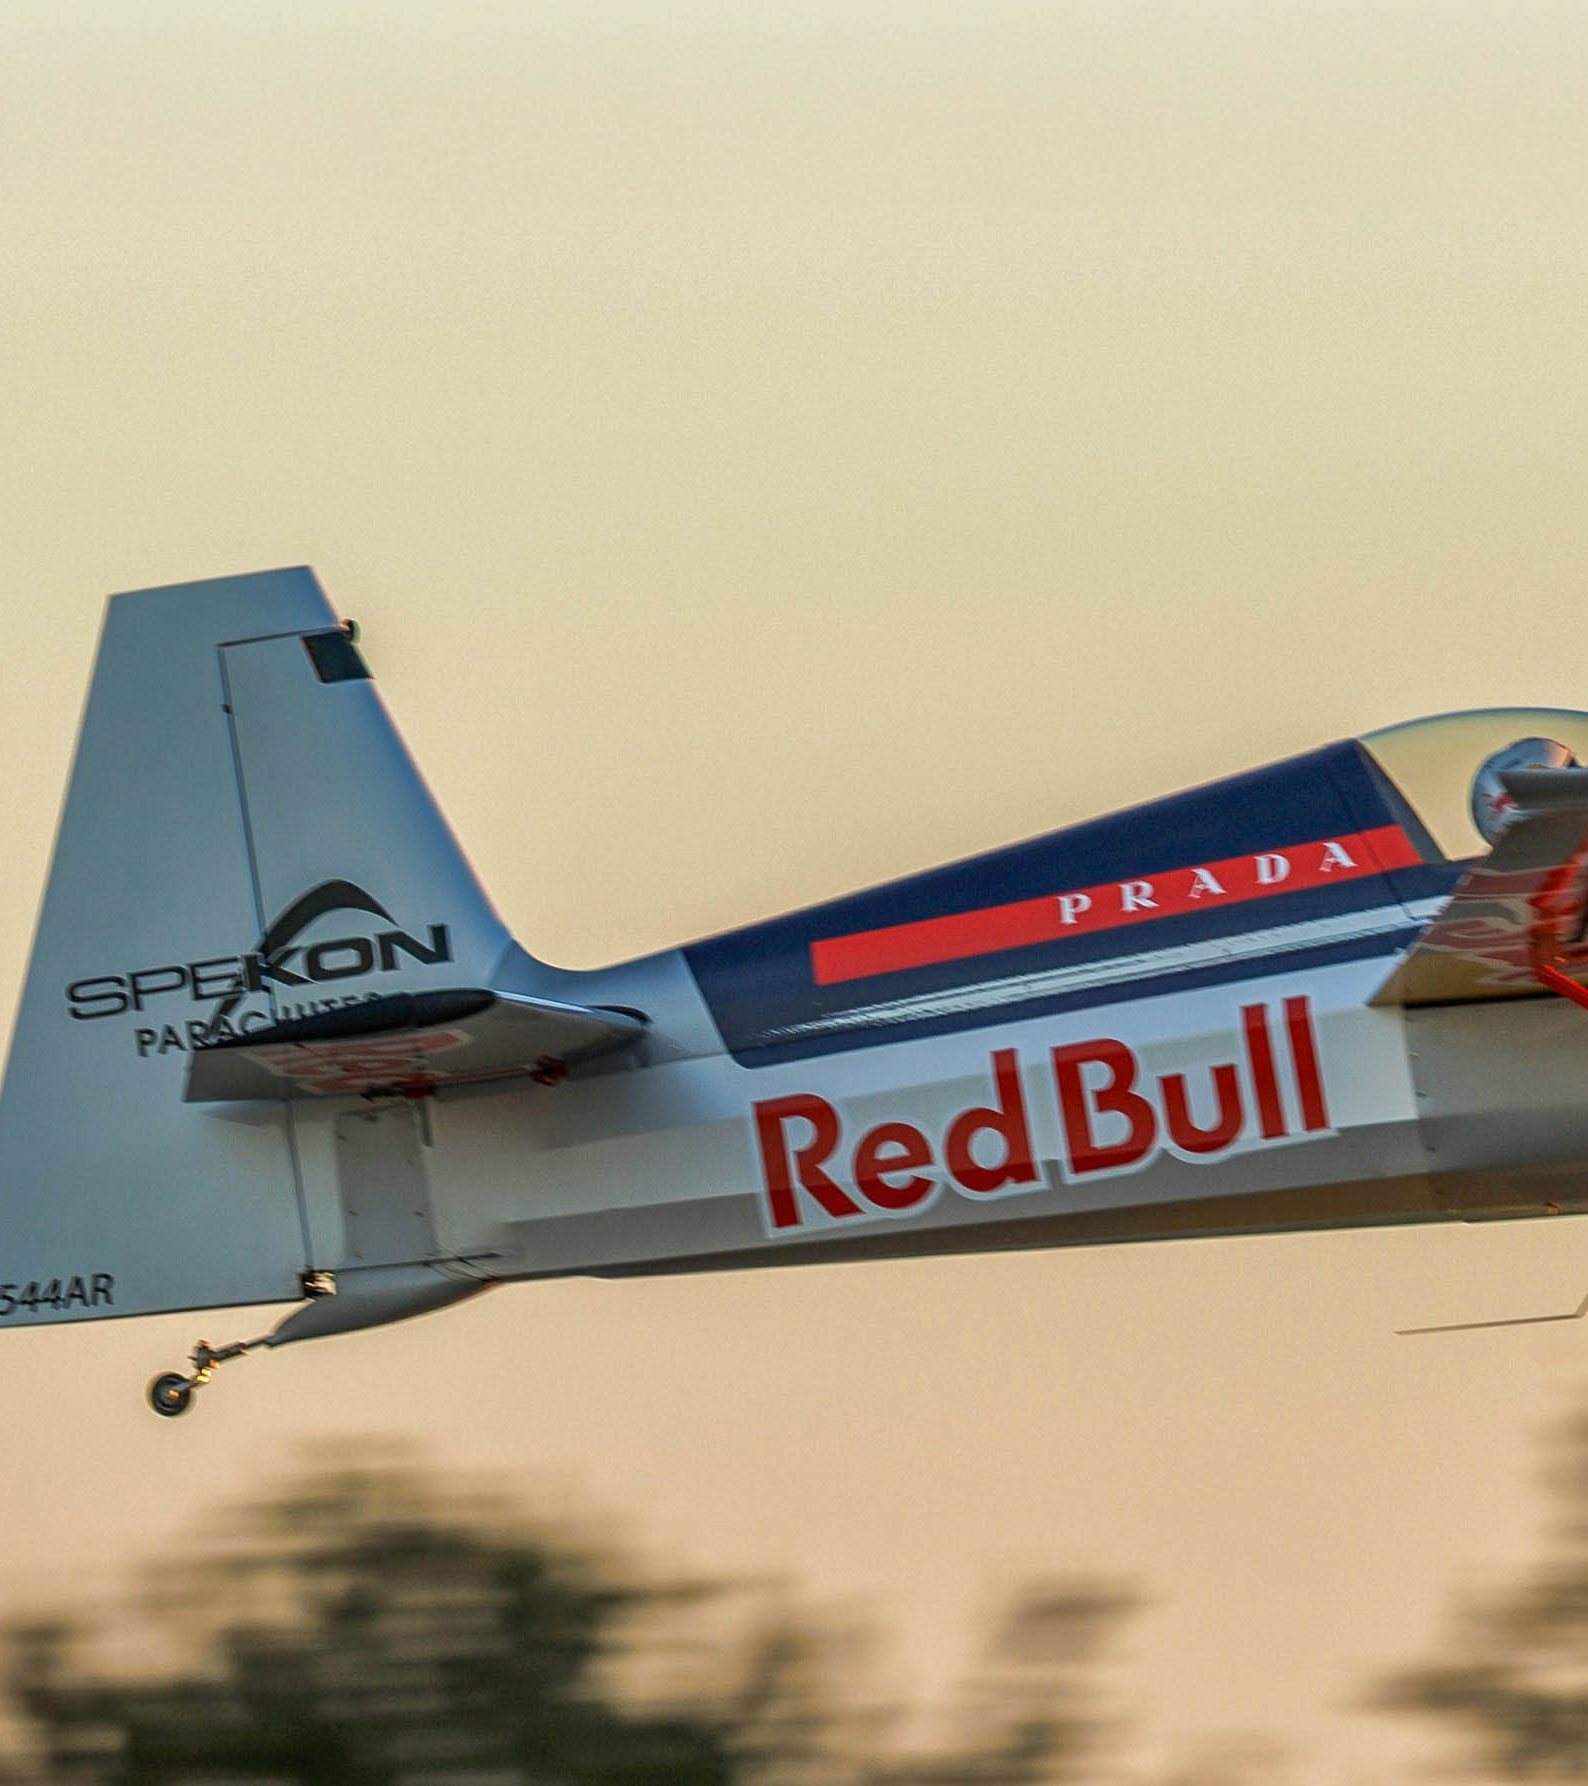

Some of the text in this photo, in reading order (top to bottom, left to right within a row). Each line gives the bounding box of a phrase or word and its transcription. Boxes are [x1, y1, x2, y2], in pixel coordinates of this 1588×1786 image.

[1058, 841, 1359, 925] PRADA
[66, 924, 453, 1020] SPEKON
[753, 994, 1330, 1229] Red Bull
